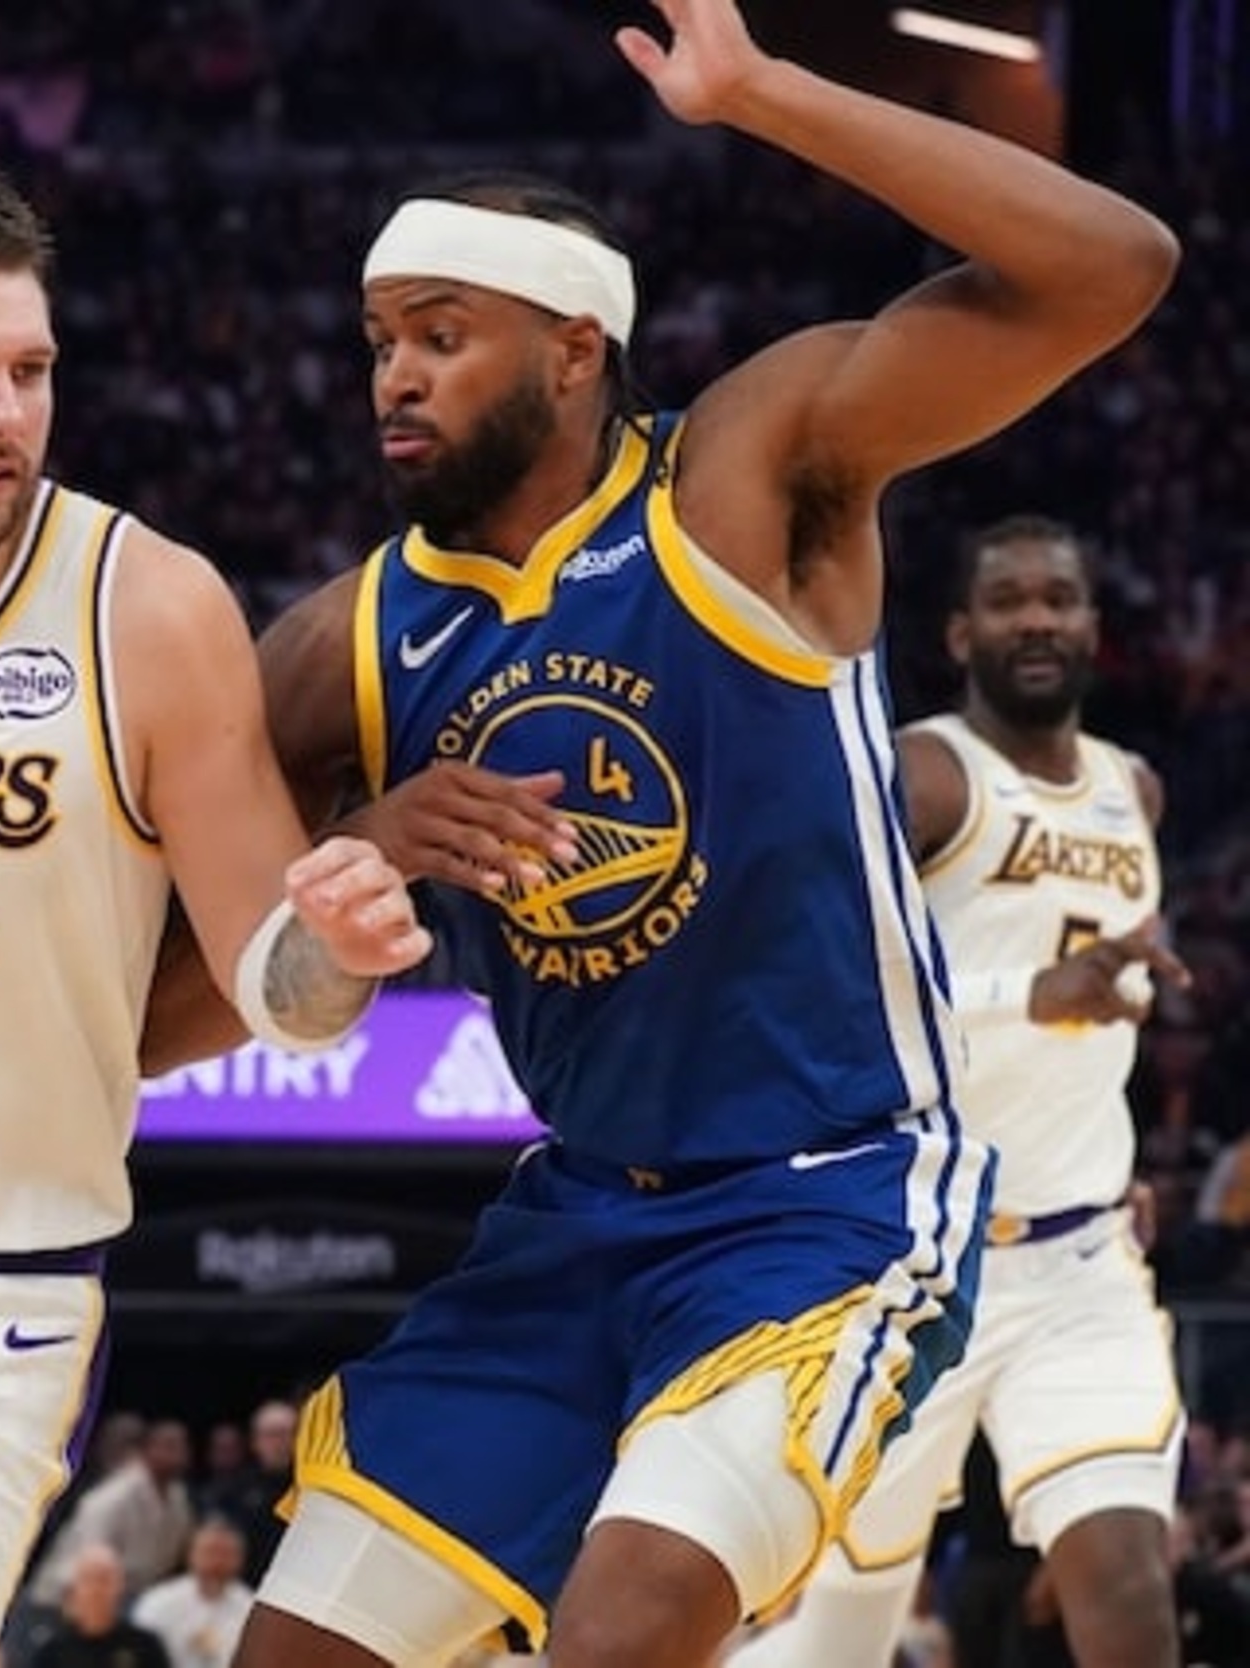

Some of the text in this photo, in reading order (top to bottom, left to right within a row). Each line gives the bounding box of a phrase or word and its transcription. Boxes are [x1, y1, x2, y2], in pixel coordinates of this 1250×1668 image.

[434, 653, 655, 763] OLDEN STATE
[589, 736, 633, 802] 4
[983, 813, 1145, 902] LAKERS
[140, 1029, 371, 1098] NTRY
